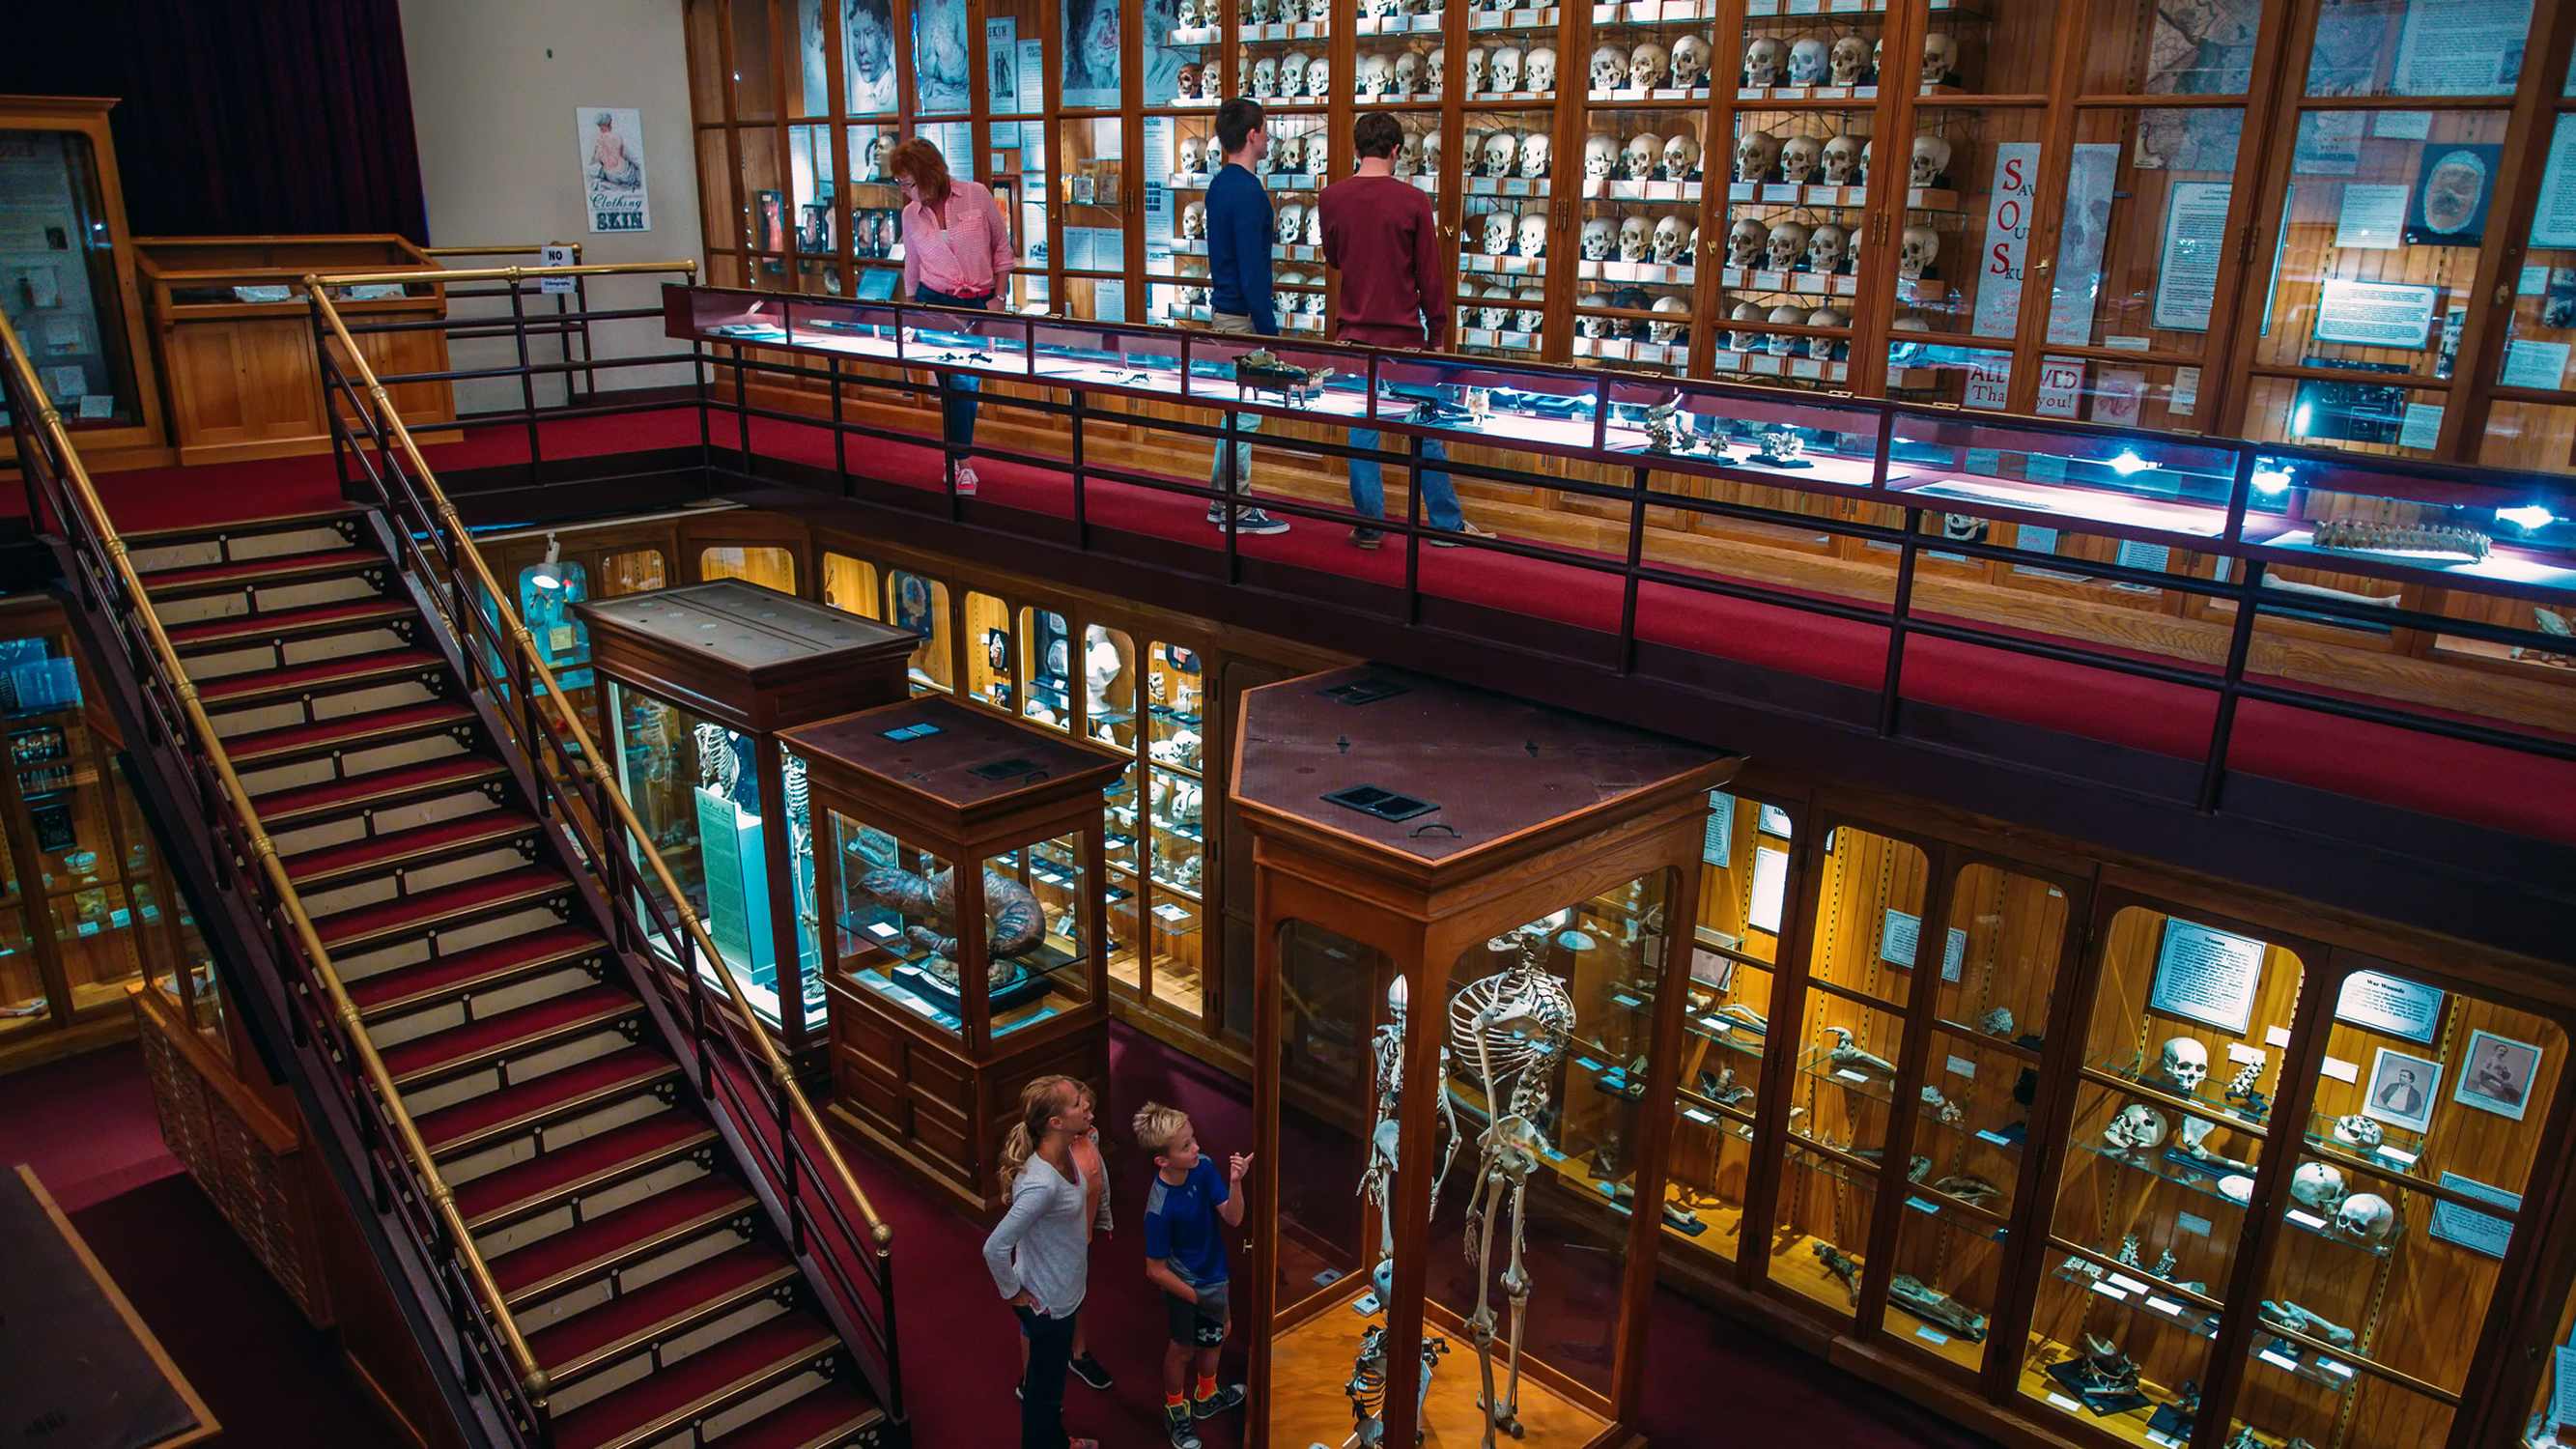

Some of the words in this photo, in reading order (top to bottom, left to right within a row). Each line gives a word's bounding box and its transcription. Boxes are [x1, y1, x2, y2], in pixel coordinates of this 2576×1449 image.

[2002, 159, 2036, 197] SAV
[589, 193, 642, 211] Clothing
[596, 212, 643, 230] SKIN
[1997, 200, 2030, 240] OU
[548, 250, 562, 261] NO
[1990, 243, 2024, 281] SKU
[1970, 364, 2005, 384] ALL
[2040, 369, 2078, 389] VED
[1972, 384, 2005, 403] Tha
[2036, 394, 2072, 410] you!
[2381, 982, 2405, 994] Wounds
